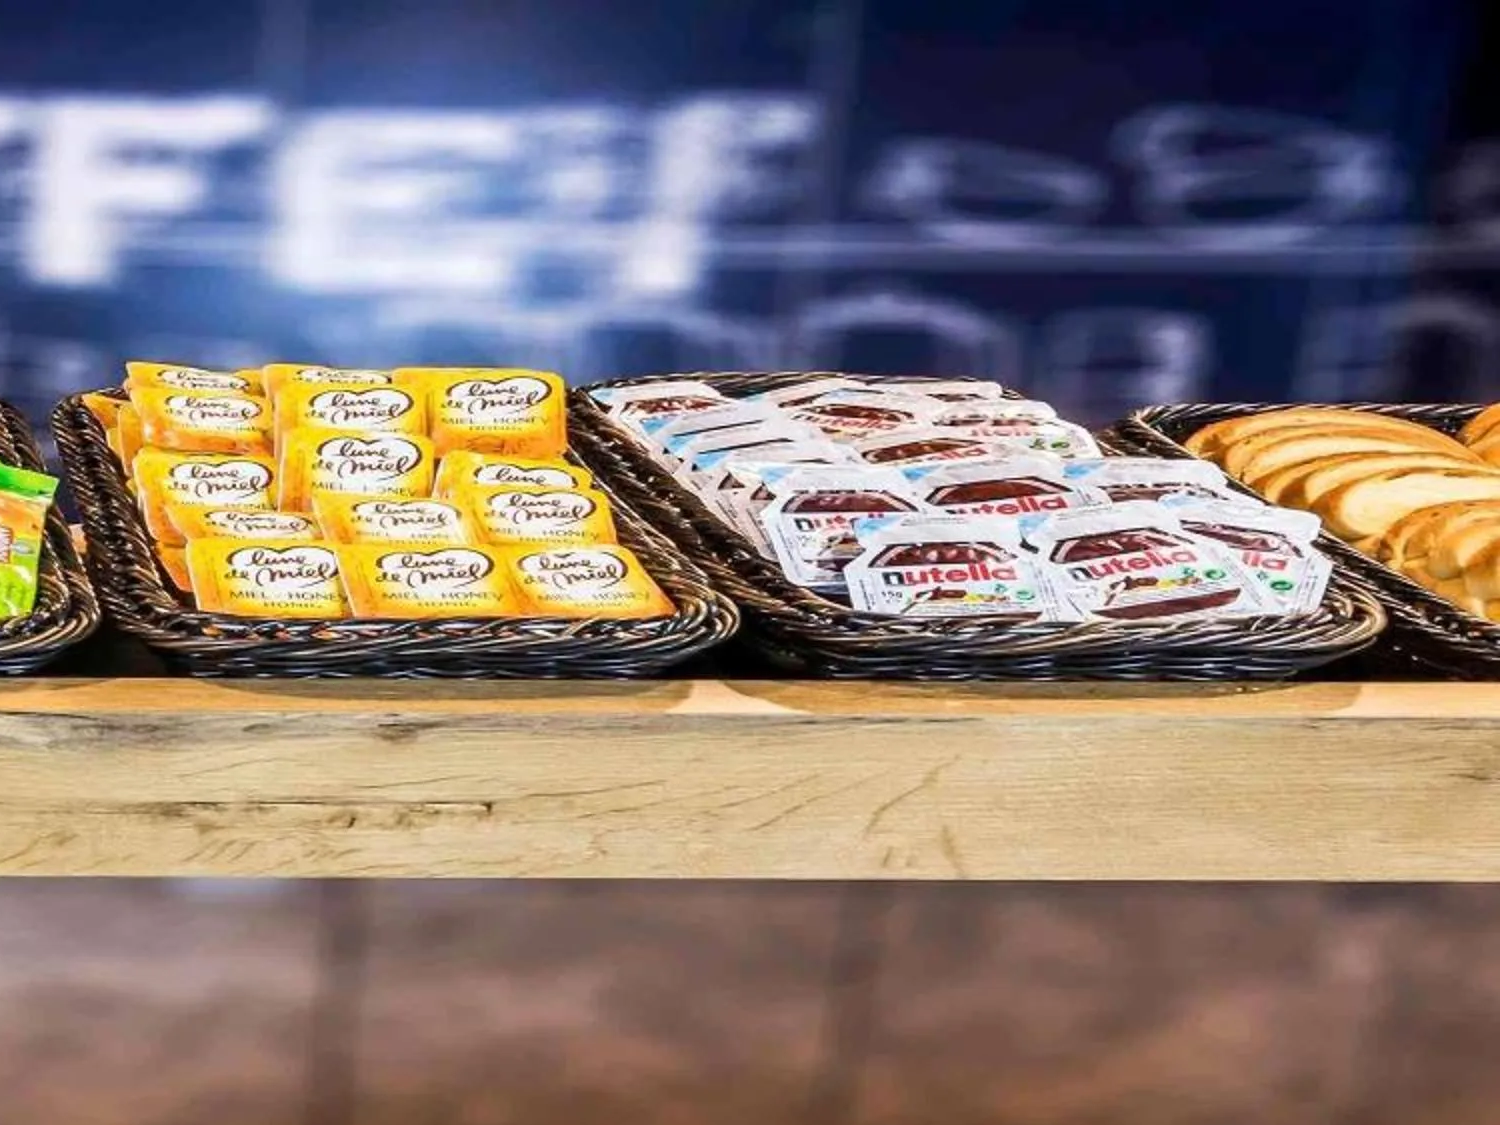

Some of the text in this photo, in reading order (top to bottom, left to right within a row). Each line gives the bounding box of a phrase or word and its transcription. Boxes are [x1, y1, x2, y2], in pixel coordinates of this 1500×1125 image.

[468, 382, 520, 397] lune
[329, 393, 381, 407] lune
[467, 392, 541, 415] miel
[338, 441, 390, 457] lune
[190, 465, 241, 479] lune
[337, 456, 408, 478] miel
[493, 467, 548, 484] lune
[509, 494, 564, 508] lune
[249, 550, 306, 566] lune
[400, 554, 457, 568] lune
[539, 552, 592, 570] lune
[1068, 548, 1199, 581] nutella
[255, 563, 331, 587] miel
[406, 563, 482, 589] miel
[881, 560, 1019, 586] nutella
